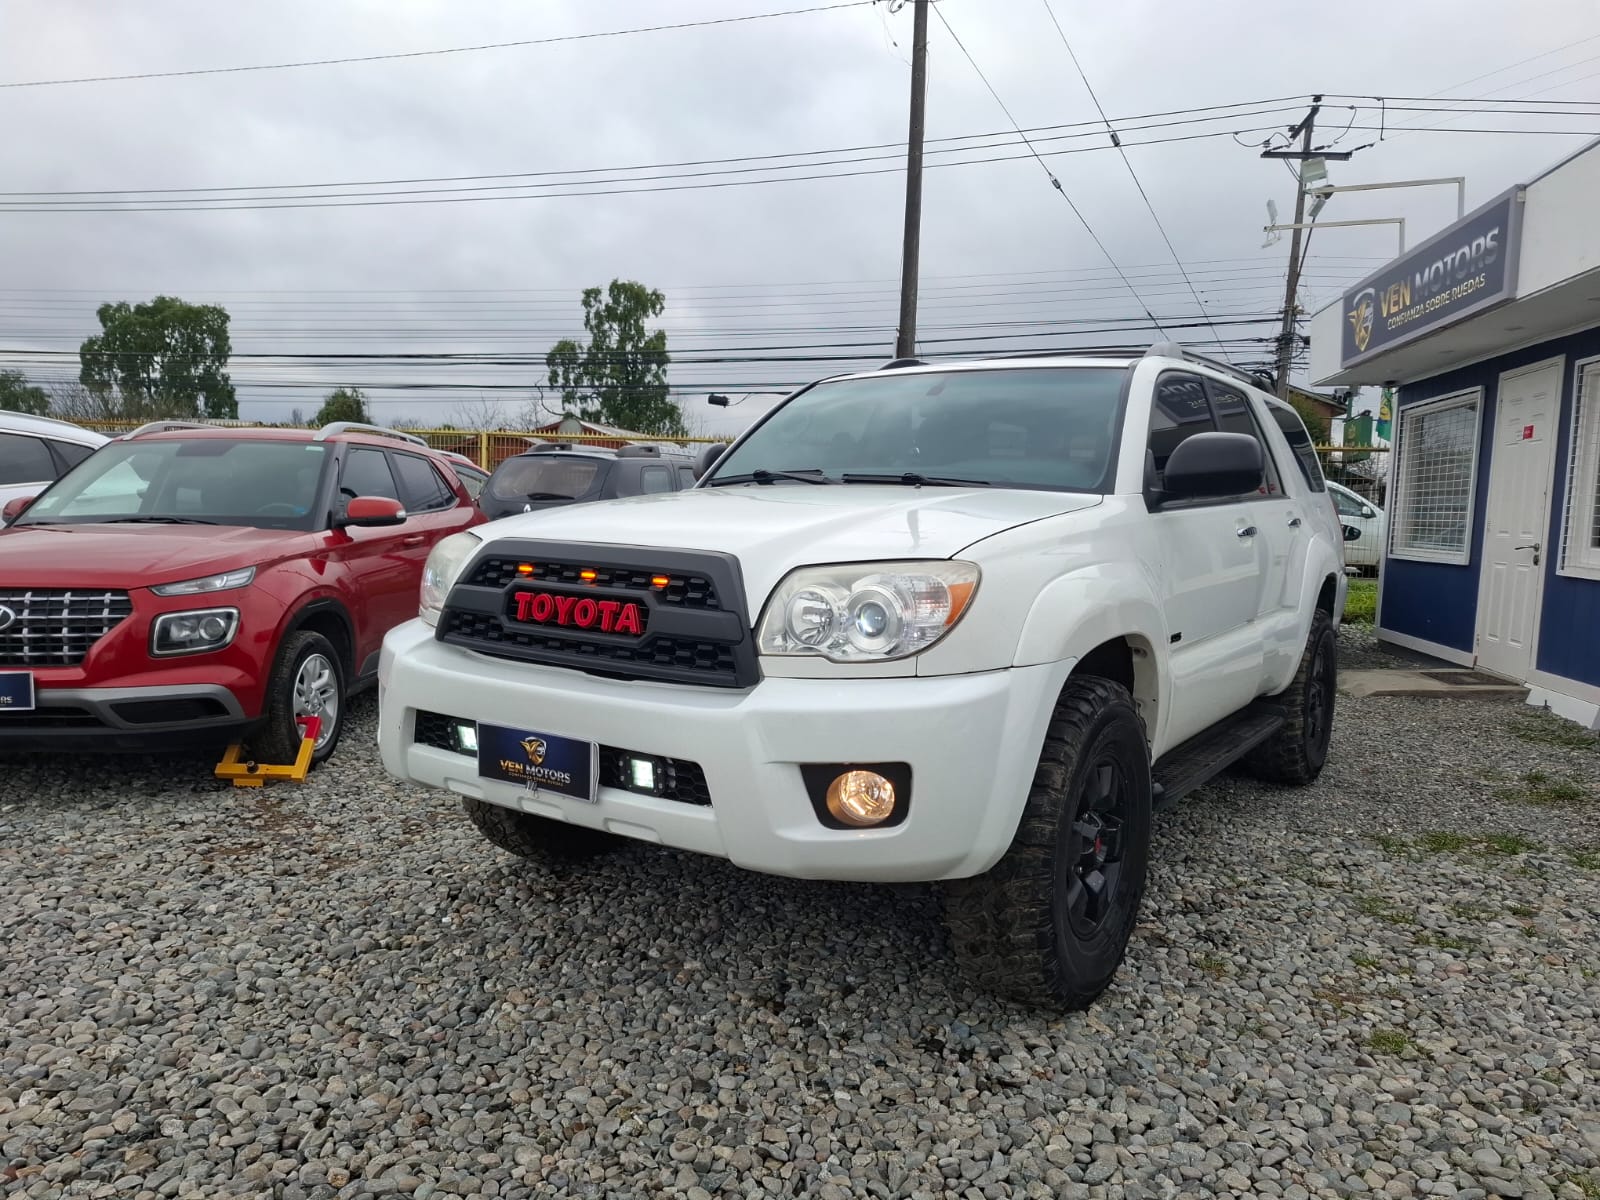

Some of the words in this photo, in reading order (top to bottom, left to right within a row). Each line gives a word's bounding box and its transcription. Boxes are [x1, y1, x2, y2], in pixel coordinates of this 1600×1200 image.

[1380, 276, 1411, 318] VEN
[1415, 227, 1499, 300] MOTORS
[1387, 304, 1425, 330] CONFIANZA
[1425, 289, 1451, 313] SOBRE
[1451, 273, 1486, 301] RUEDAS
[515, 592, 641, 634] TOYOTA
[500, 759, 524, 773] VEN
[525, 764, 571, 784] MOTORS
